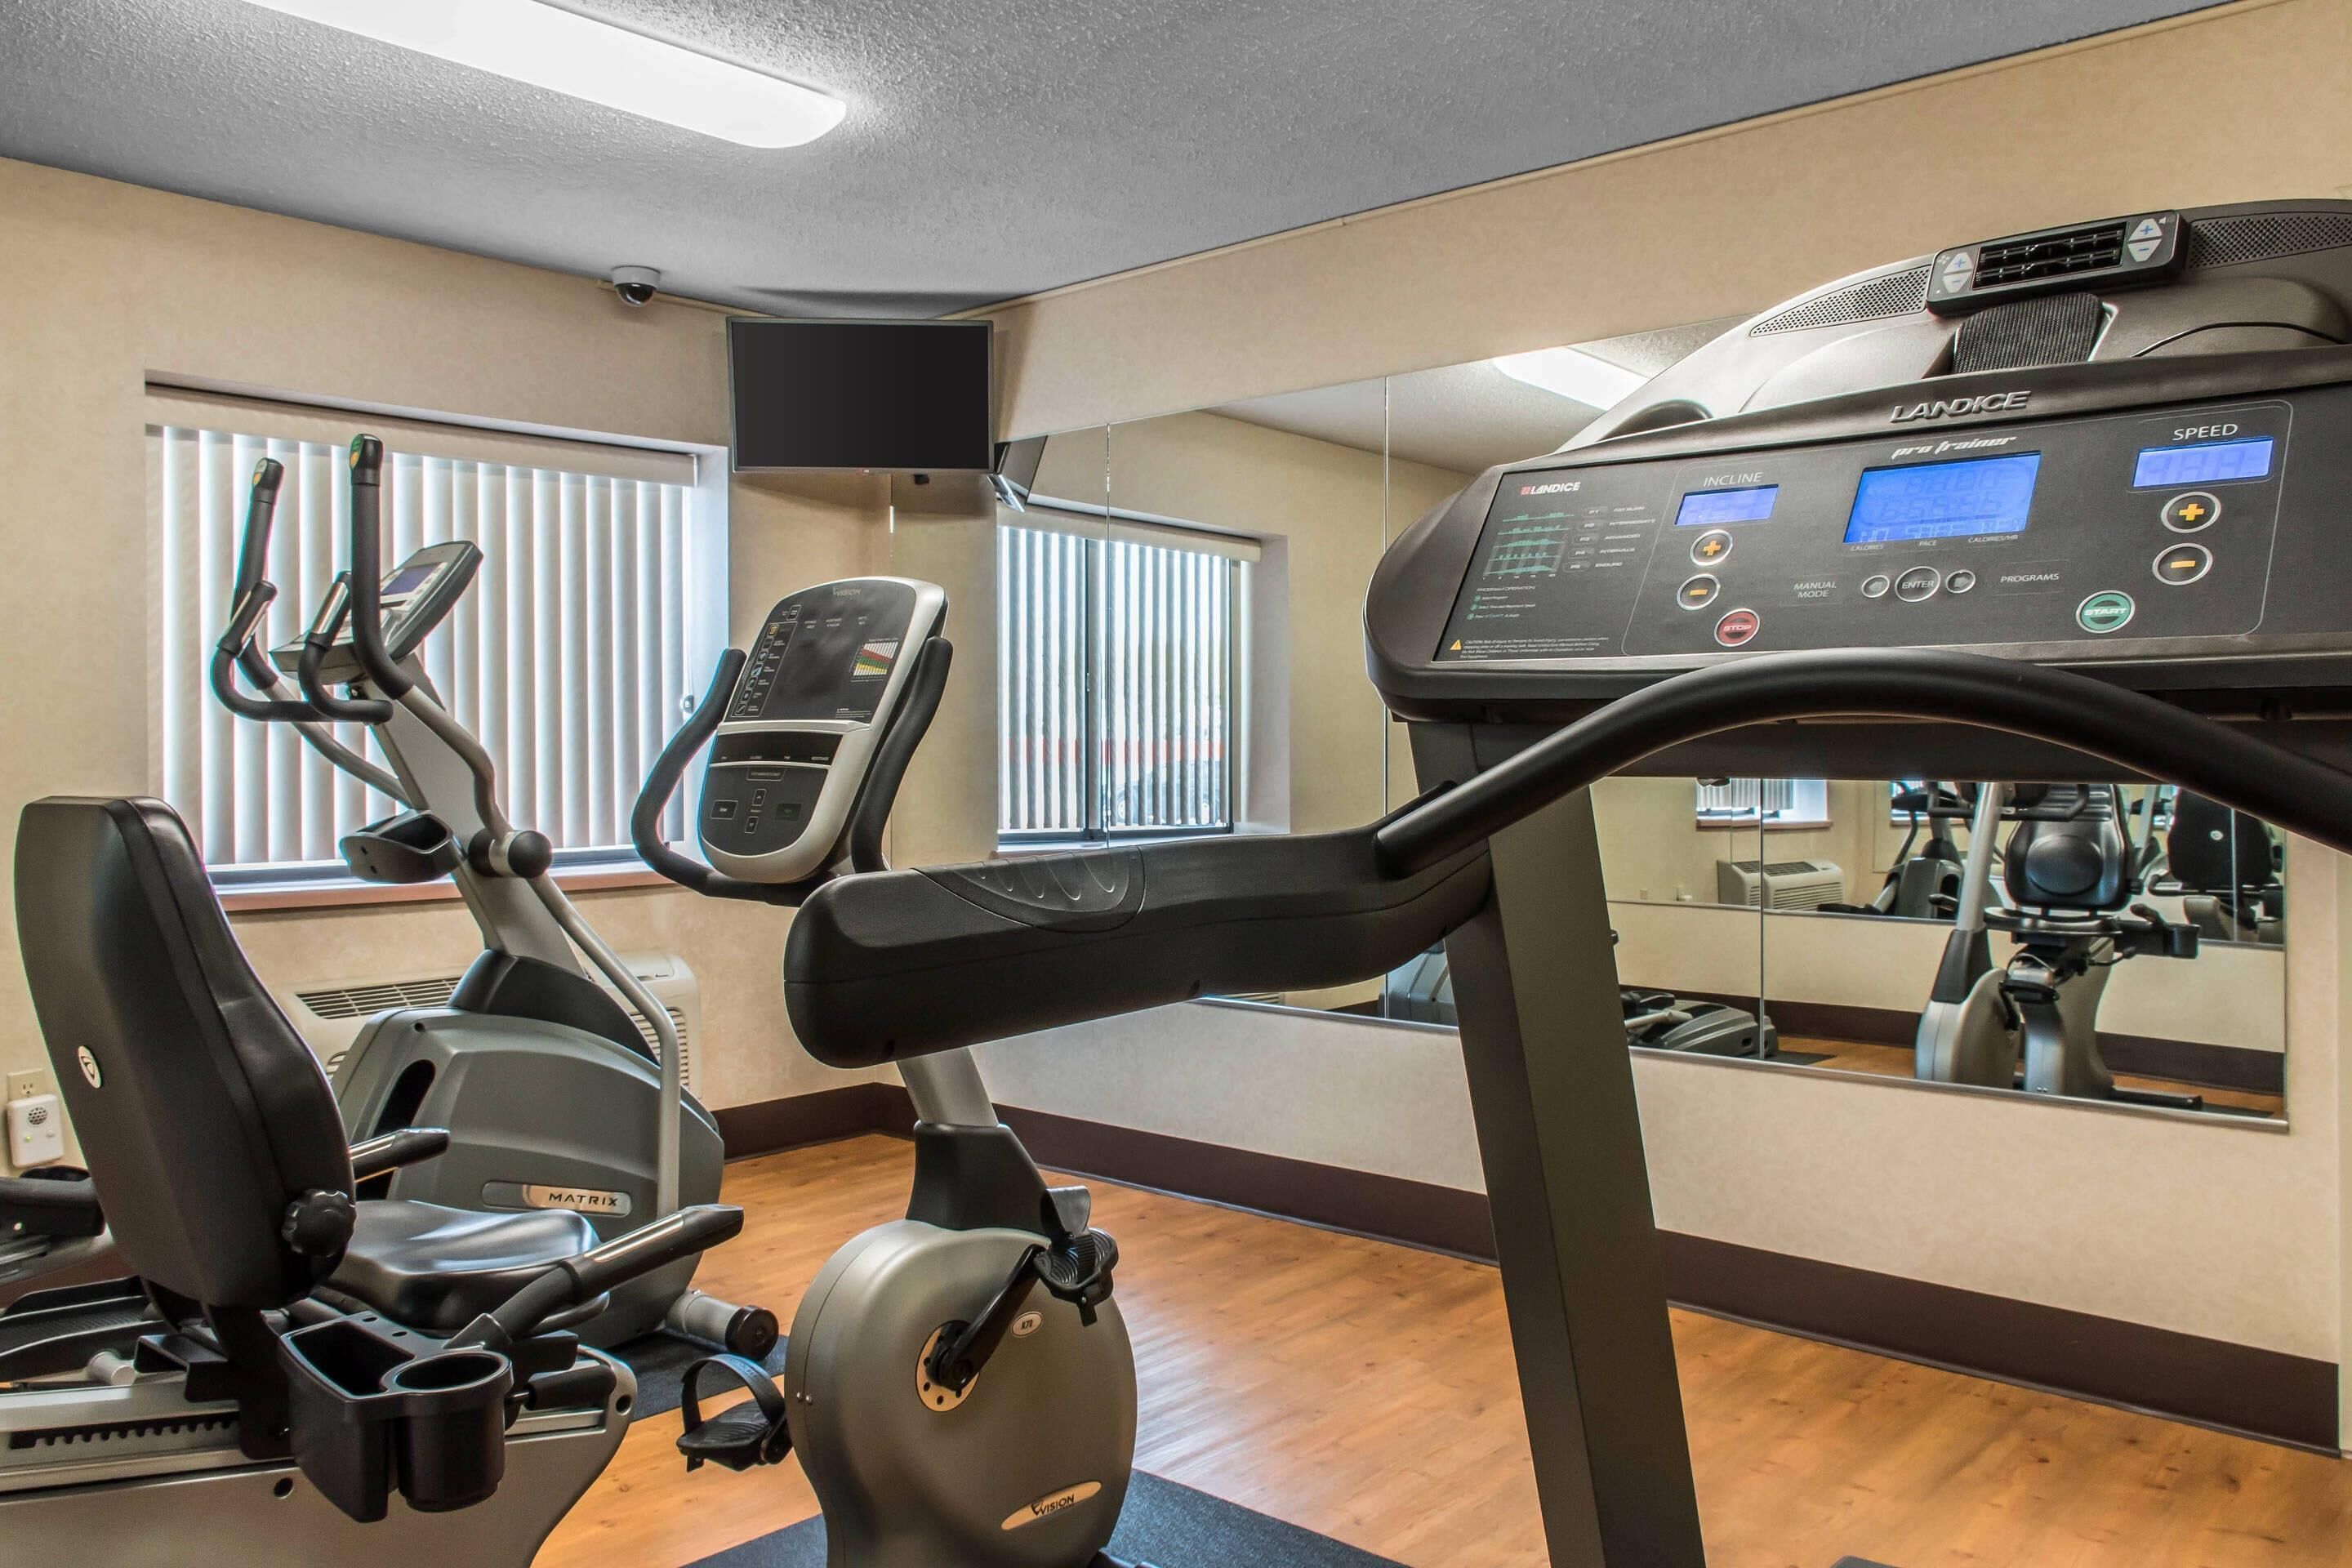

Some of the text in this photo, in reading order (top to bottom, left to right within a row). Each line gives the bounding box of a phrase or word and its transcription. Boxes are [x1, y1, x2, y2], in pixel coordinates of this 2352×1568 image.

[1890, 390, 2031, 423] LANDICE
[2172, 423, 2238, 441] SPEED
[1891, 437, 2017, 460] pro trainer
[1704, 472, 1763, 487] INCLINE
[1530, 482, 1581, 495] LANDICE
[1967, 535, 2019, 543] CALORIES/HR
[1850, 543, 1884, 551] CALORIES
[2000, 572, 2060, 582] PROGRAMS
[1793, 581, 1837, 590] MANUAL
[1901, 580, 1935, 589] ENTER
[1797, 590, 1829, 598] MODE
[2084, 607, 2127, 616] START
[548, 1192, 618, 1206] MATRIX
[1039, 1493, 1075, 1515] VISION
